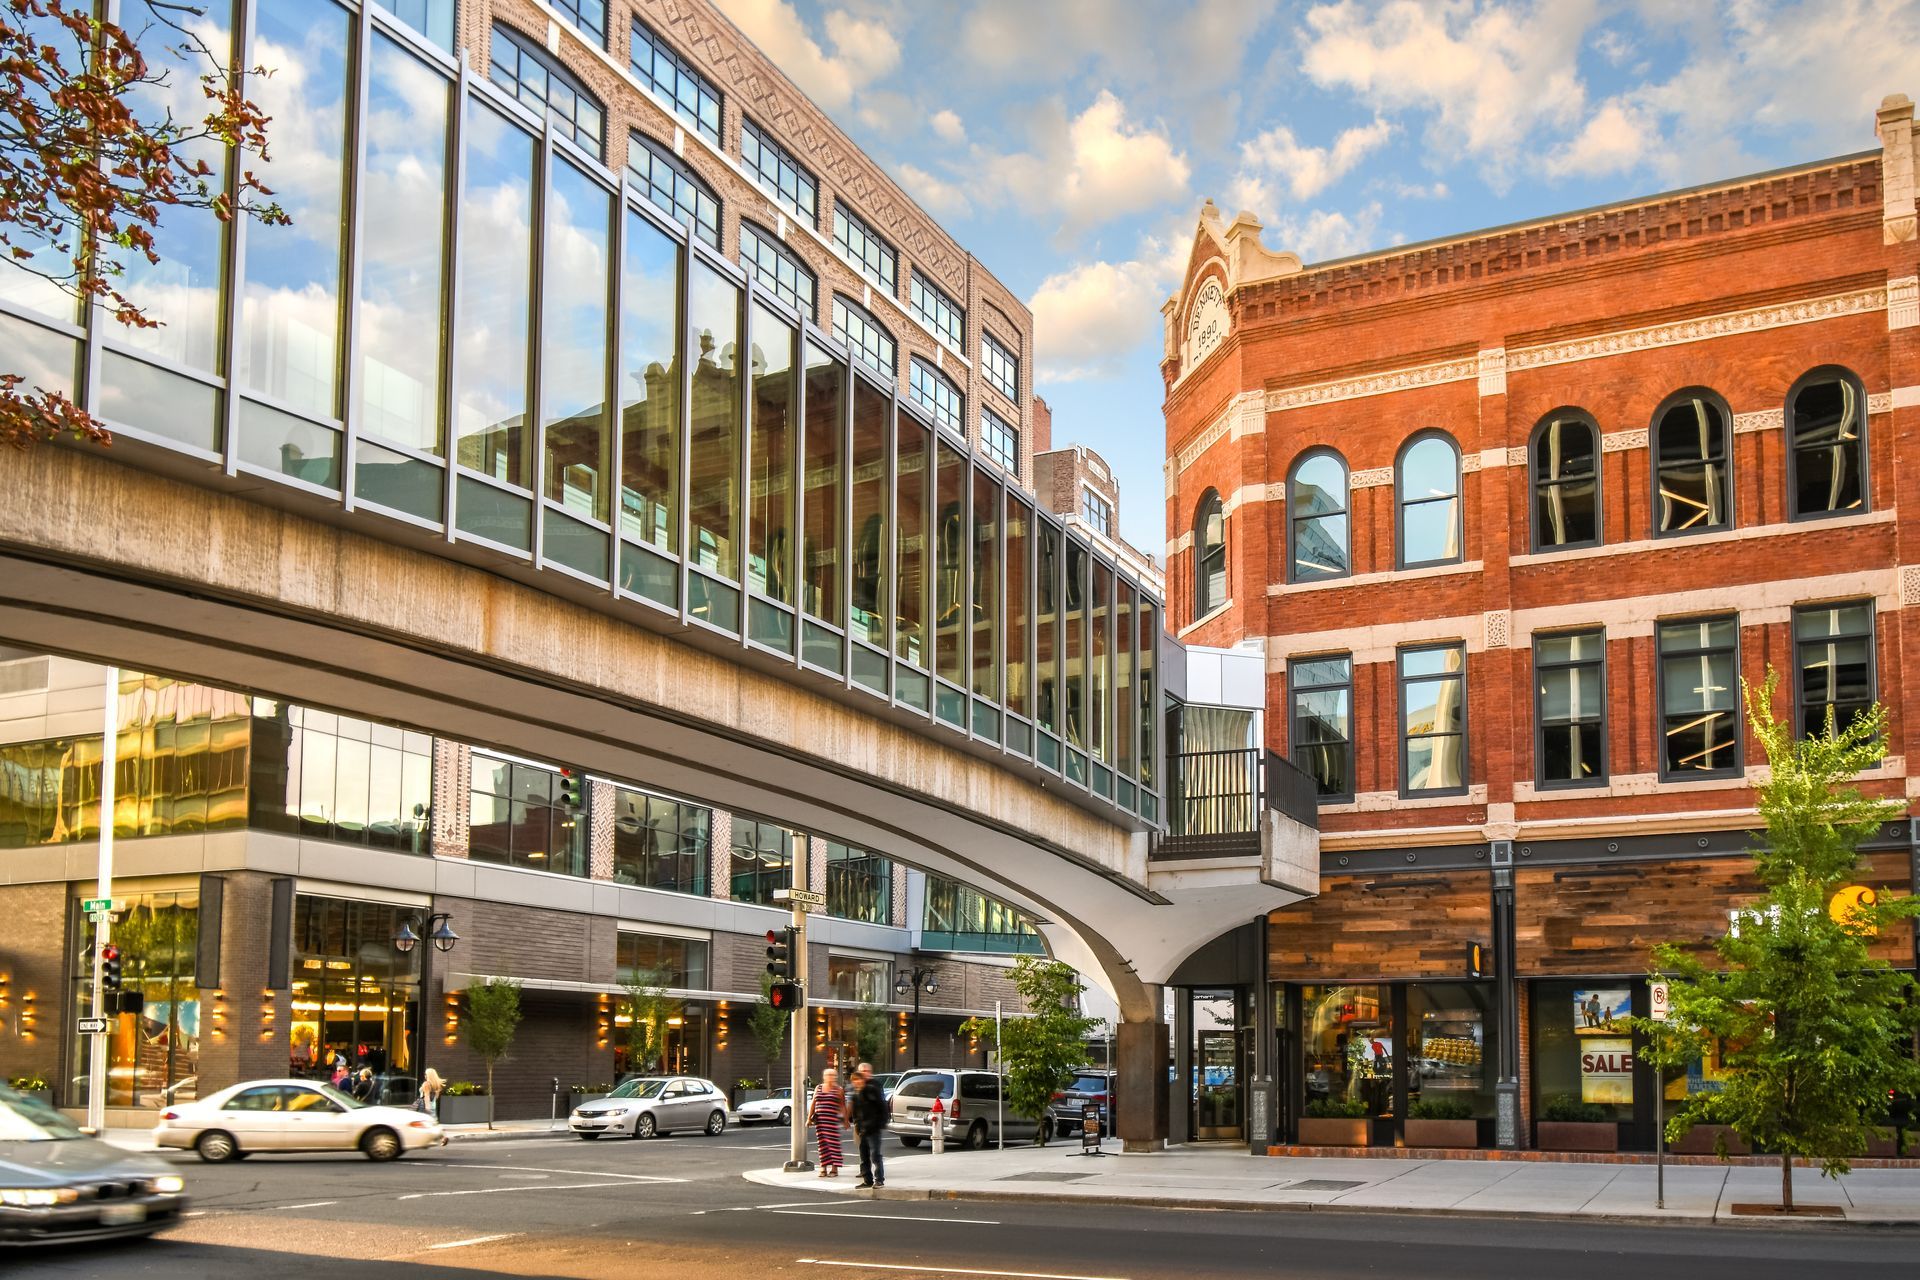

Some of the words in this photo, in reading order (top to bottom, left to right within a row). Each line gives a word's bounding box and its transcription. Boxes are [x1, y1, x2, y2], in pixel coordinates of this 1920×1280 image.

[1198, 319, 1217, 349] 1890
[794, 891, 820, 902] HOWARD
[90, 900, 105, 910] Main
[1582, 1054, 1633, 1073] SALE
